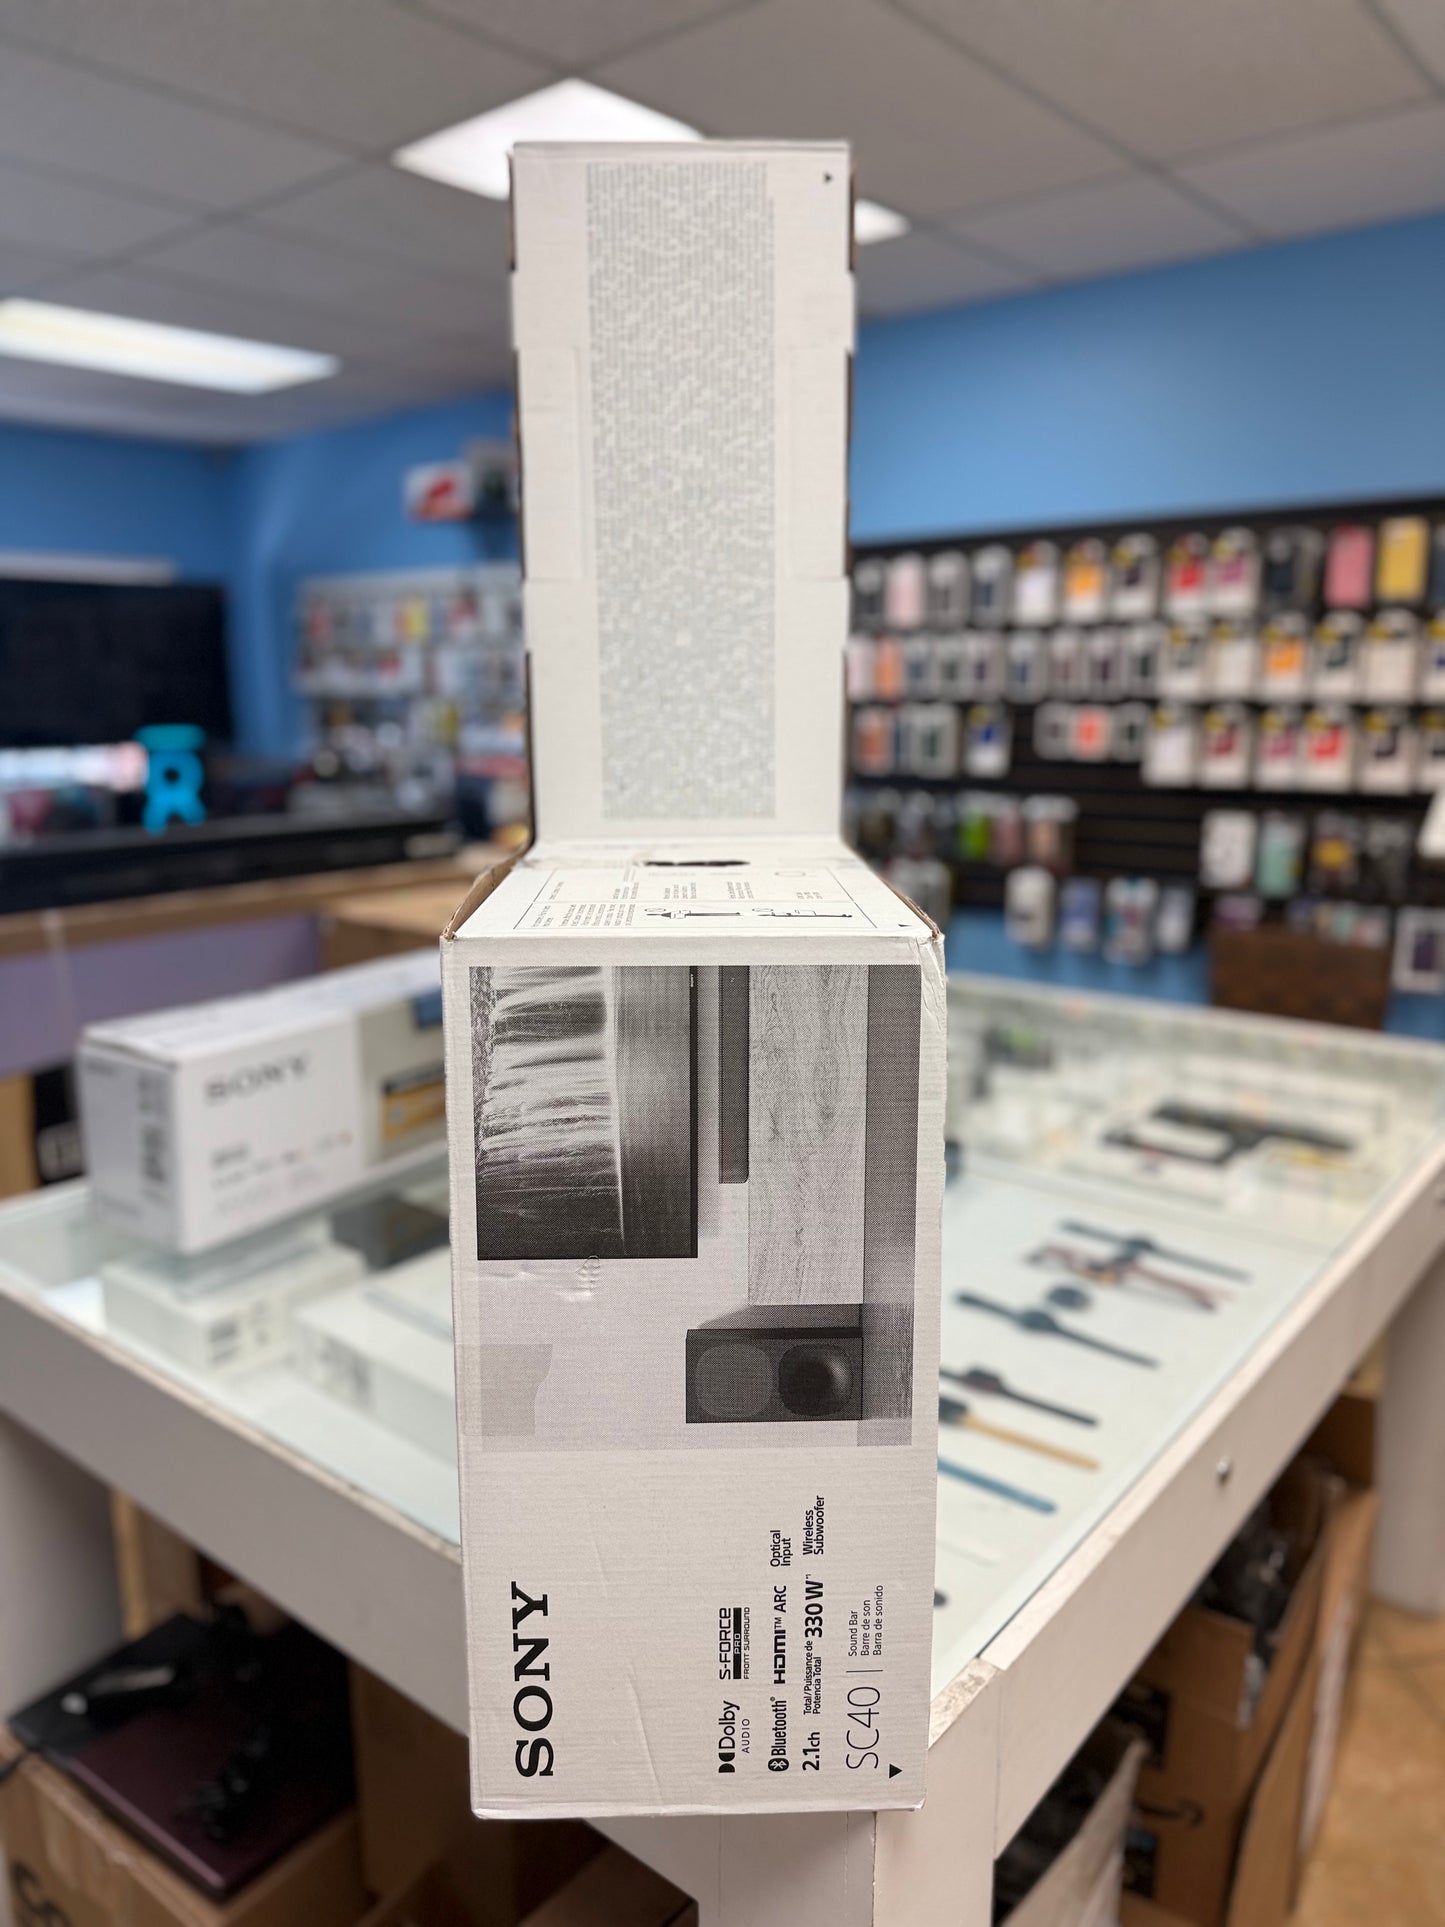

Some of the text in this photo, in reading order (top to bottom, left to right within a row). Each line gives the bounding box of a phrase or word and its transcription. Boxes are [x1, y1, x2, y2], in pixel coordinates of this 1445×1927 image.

[770, 1529, 782, 1567] Optical
[803, 1509, 814, 1555] Wireless
[813, 1495, 825, 1555] Subwoofer
[781, 1537, 793, 1566] Input
[773, 1585, 787, 1613] ARC
[804, 1603, 823, 1638] 330
[872, 1585, 884, 1656] Barra de sonido
[719, 1607, 731, 1680] S-FORCE
[804, 1640, 813, 1651] de
[848, 1610, 858, 1657] Sound Bar
[860, 1599, 871, 1656] Barre de son
[511, 1581, 554, 1777] SONY
[813, 1656, 822, 1714] Potencia Total
[718, 1700, 740, 1749] Dolby
[741, 1718, 750, 1754] AUDIO
[845, 1686, 881, 1769] SC40
[802, 1731, 820, 1771] 2.1ch
